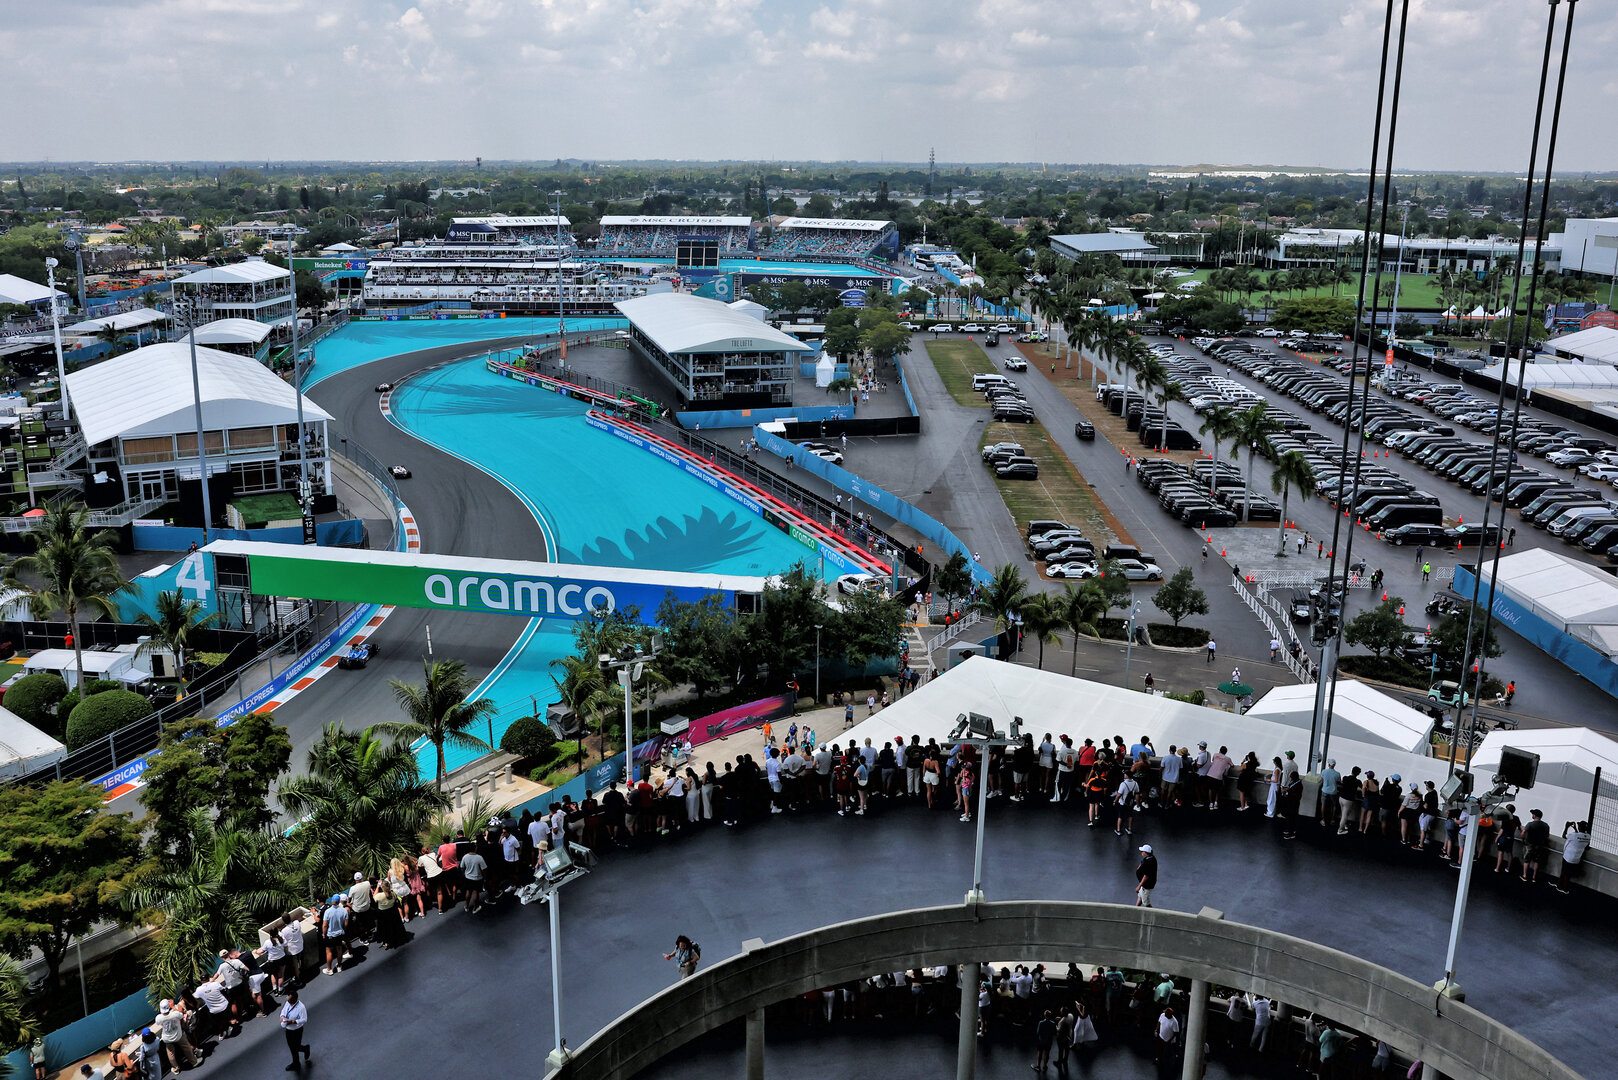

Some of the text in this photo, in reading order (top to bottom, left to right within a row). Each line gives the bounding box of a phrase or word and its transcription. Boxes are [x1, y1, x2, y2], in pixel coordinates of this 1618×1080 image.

[715, 277, 729, 295] 6
[812, 278, 830, 286] MSC
[855, 279, 873, 287] MSC
[614, 428, 643, 447] AMERICAN EXPRESS
[649, 445, 680, 466] AMERICAN EXPRESS
[685, 464, 718, 488] AMERICAN EXPRESS
[725, 486, 760, 513] AMERICAN EXPRESS
[792, 528, 815, 549] aramco
[821, 546, 845, 568] aramco
[176, 552, 211, 600] 4
[181, 598, 208, 609] RIGE
[425, 574, 616, 618] aramco
[285, 639, 332, 682] AMERICAN EXPRESS
[215, 685, 275, 728] ERICAN EXPRESS
